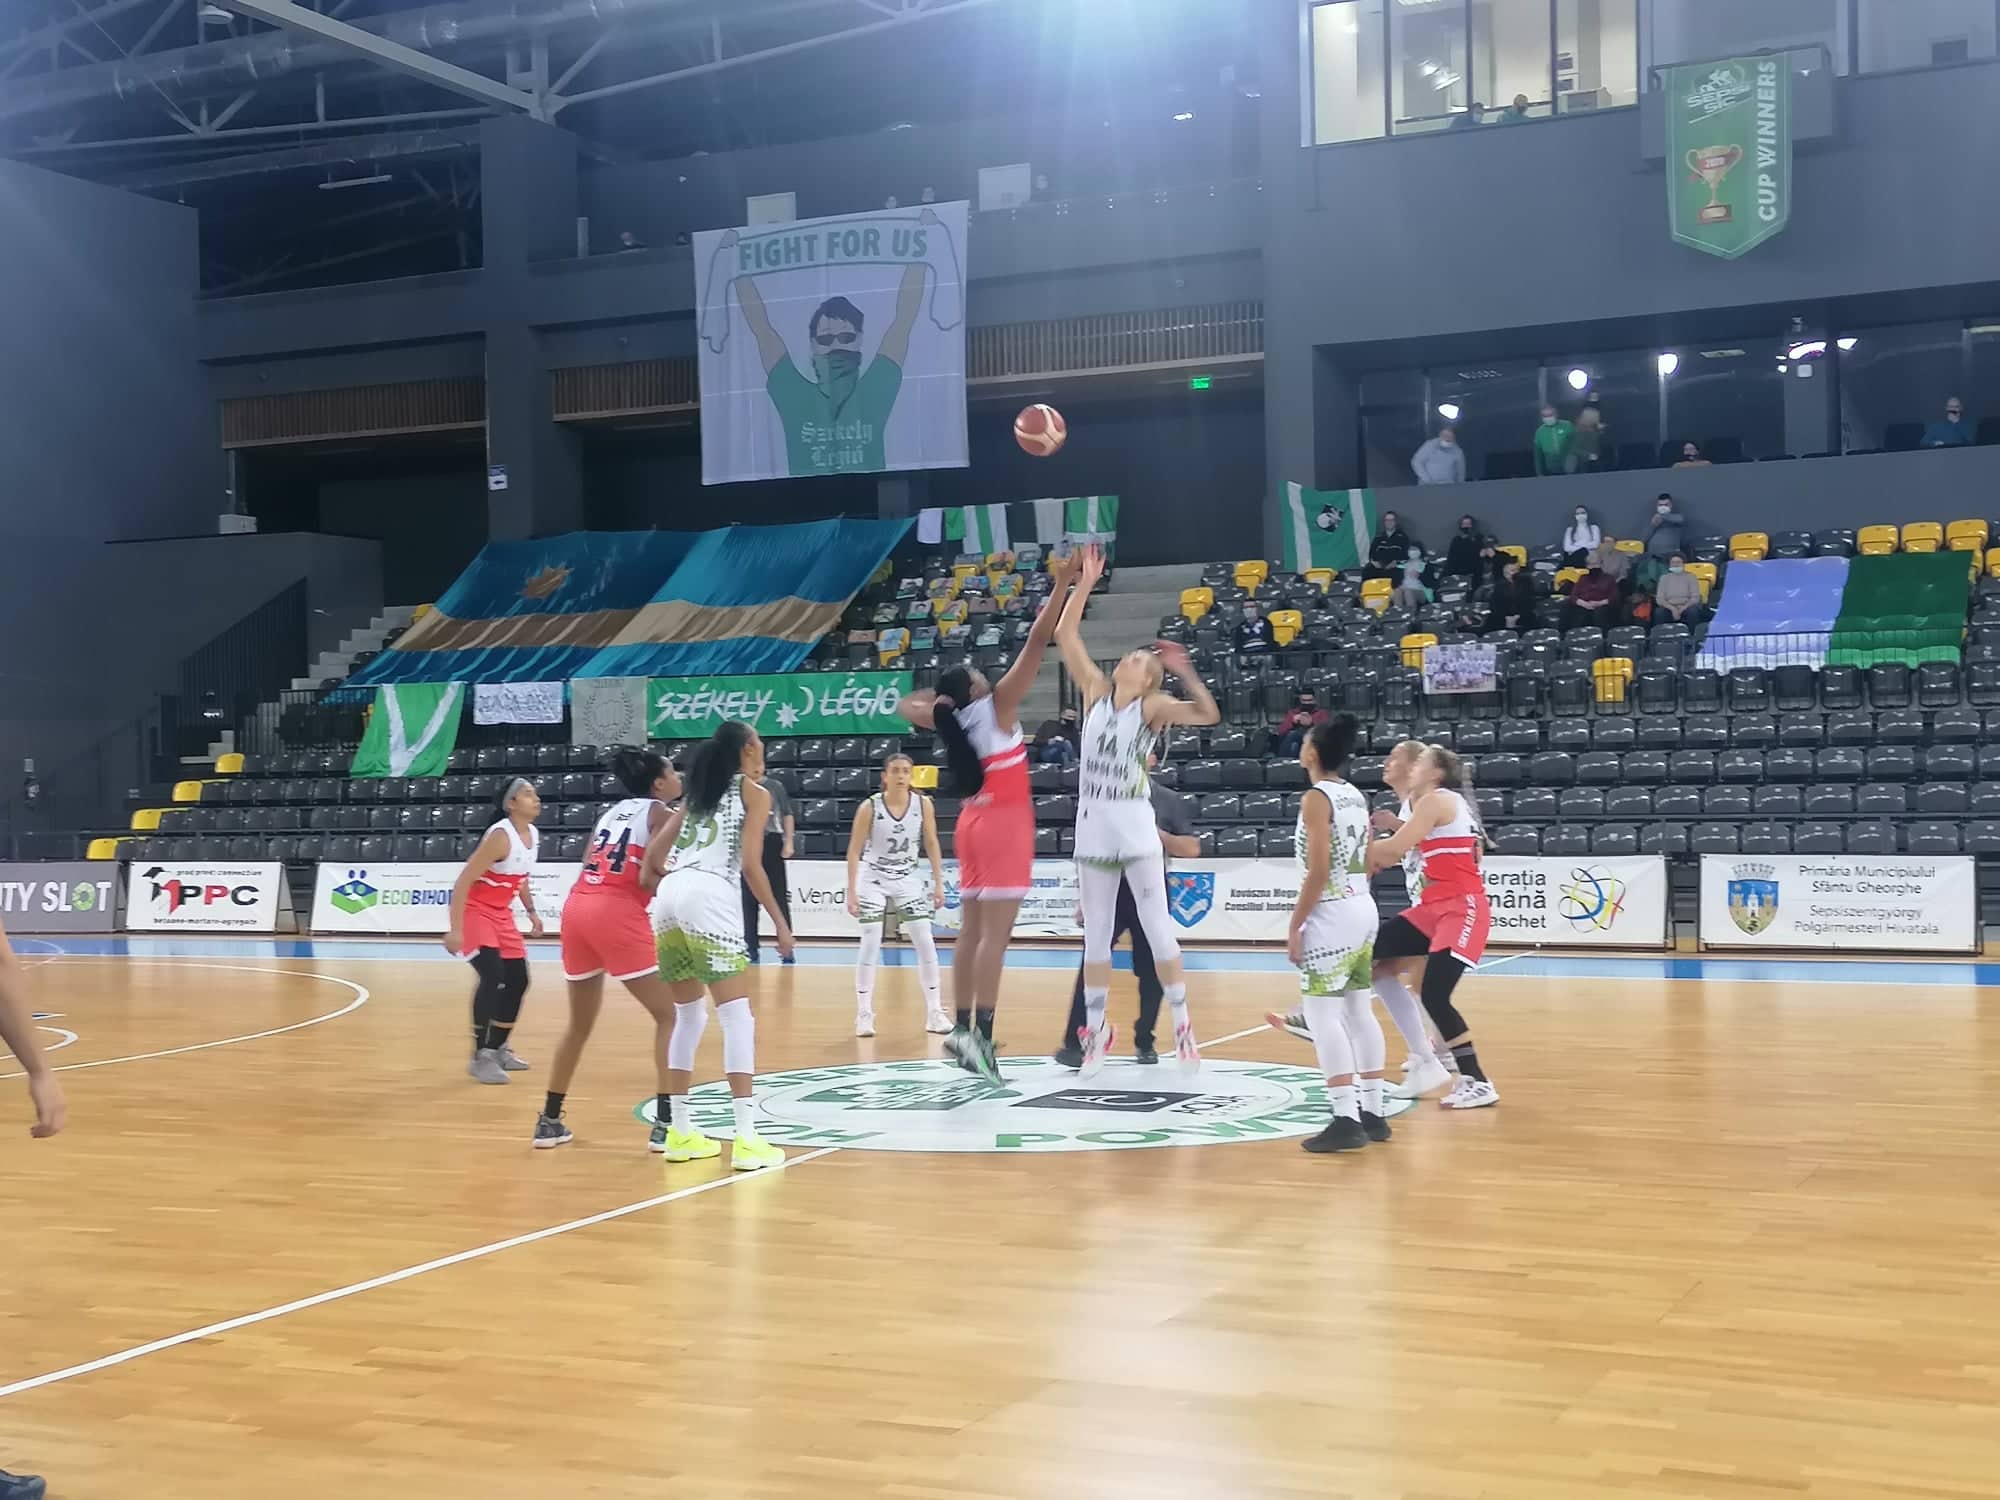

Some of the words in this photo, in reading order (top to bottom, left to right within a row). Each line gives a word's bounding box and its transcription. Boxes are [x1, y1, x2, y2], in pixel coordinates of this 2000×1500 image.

[1756, 61, 1777, 169] WINNERS
[1758, 173, 1777, 221] CUP
[739, 233, 819, 271] FIGHT
[827, 228, 880, 259] FOR
[892, 229, 928, 258] US
[654, 683, 775, 727] SZÉKELY
[818, 677, 901, 720] LÉGIÓ
[583, 826, 632, 874] 24
[886, 836, 910, 854] 24
[41, 881, 113, 912] SLOT
[798, 888, 849, 904] Vend
[1487, 890, 1547, 909] mână
[1856, 881, 1922, 896] Gheorghe
[1489, 914, 1547, 928] aschet
